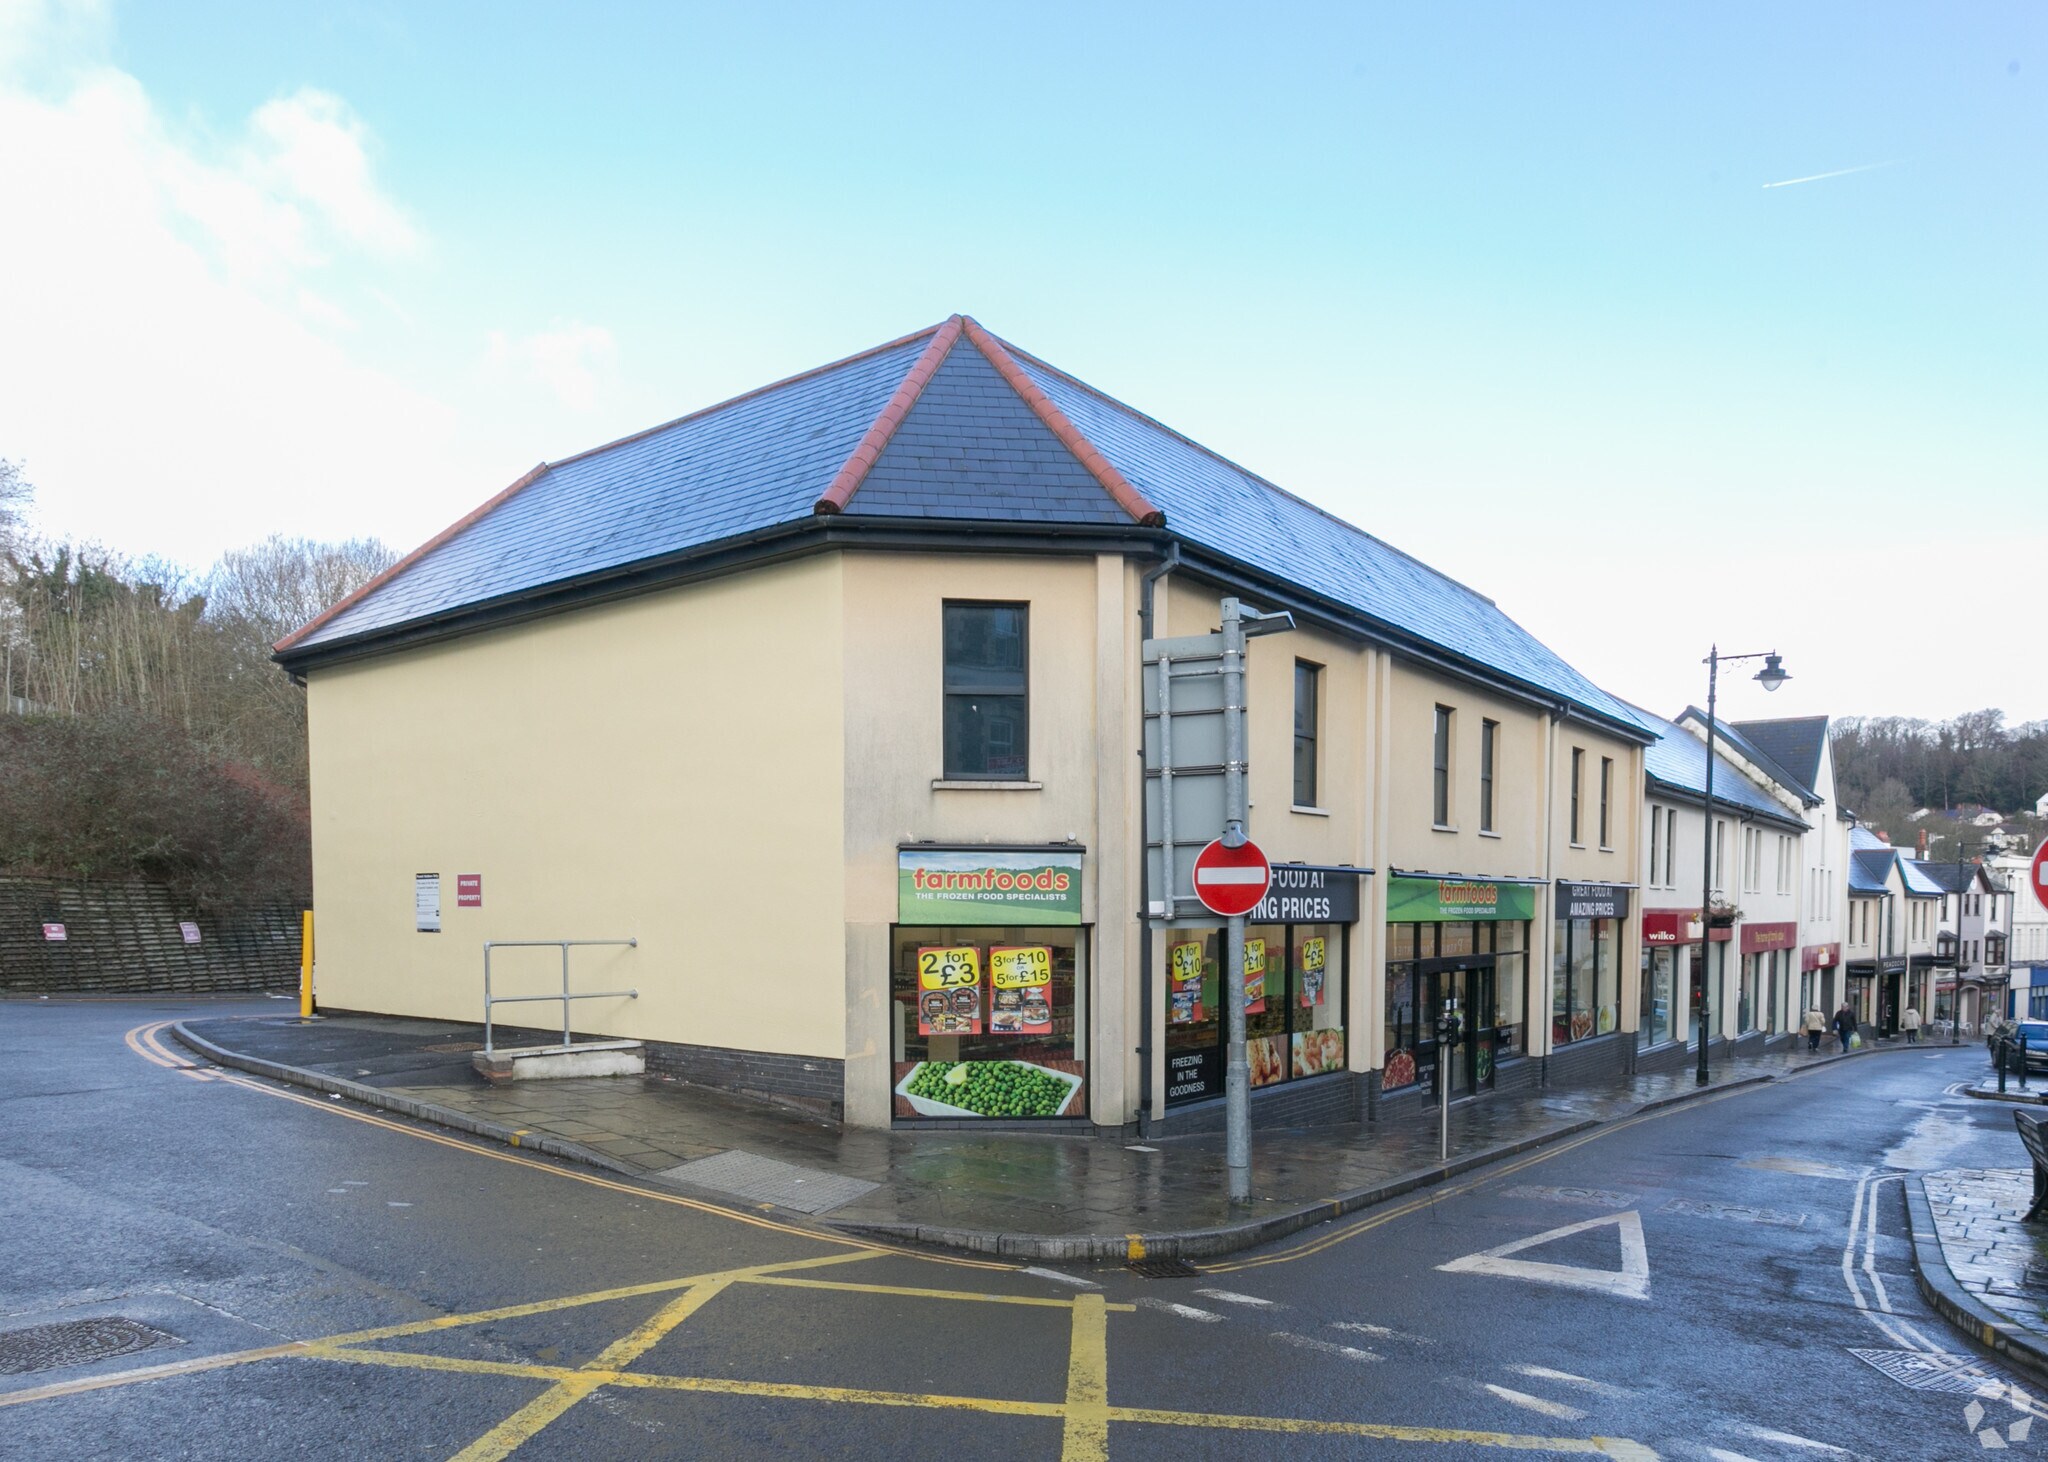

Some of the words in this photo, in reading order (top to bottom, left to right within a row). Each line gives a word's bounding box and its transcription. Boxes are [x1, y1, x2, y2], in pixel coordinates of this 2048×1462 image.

[913, 867, 1070, 892] farmfoods
[1006, 893, 1067, 901] SPECIALISTS
[1439, 880, 1497, 904] farmfoods
[1572, 886, 1590, 897] GREAT
[1281, 897, 1330, 919] PRICES
[1570, 902, 1594, 916] AMAZING
[1595, 902, 1614, 916] PRICES
[1649, 931, 1675, 940] wilko
[1252, 943, 1261, 952] for
[1305, 942, 1311, 958] 2
[922, 953, 940, 975] 2
[945, 951, 969, 963] for
[994, 955, 1003, 967] 3
[1017, 951, 1046, 965] £10
[1175, 948, 1183, 967] 3
[1186, 946, 1197, 956] for
[1248, 954, 1264, 970] £10
[1311, 949, 1323, 967] £5
[941, 963, 975, 986] £3
[1183, 958, 1200, 976] £10
[997, 973, 1006, 985] 5
[1020, 969, 1049, 983] £15
[1172, 1054, 1203, 1069] FREEZING
[1177, 1071, 1184, 1081] IN
[1185, 1069, 1198, 1080] THE
[1170, 1081, 1205, 1097] GOODNESS
